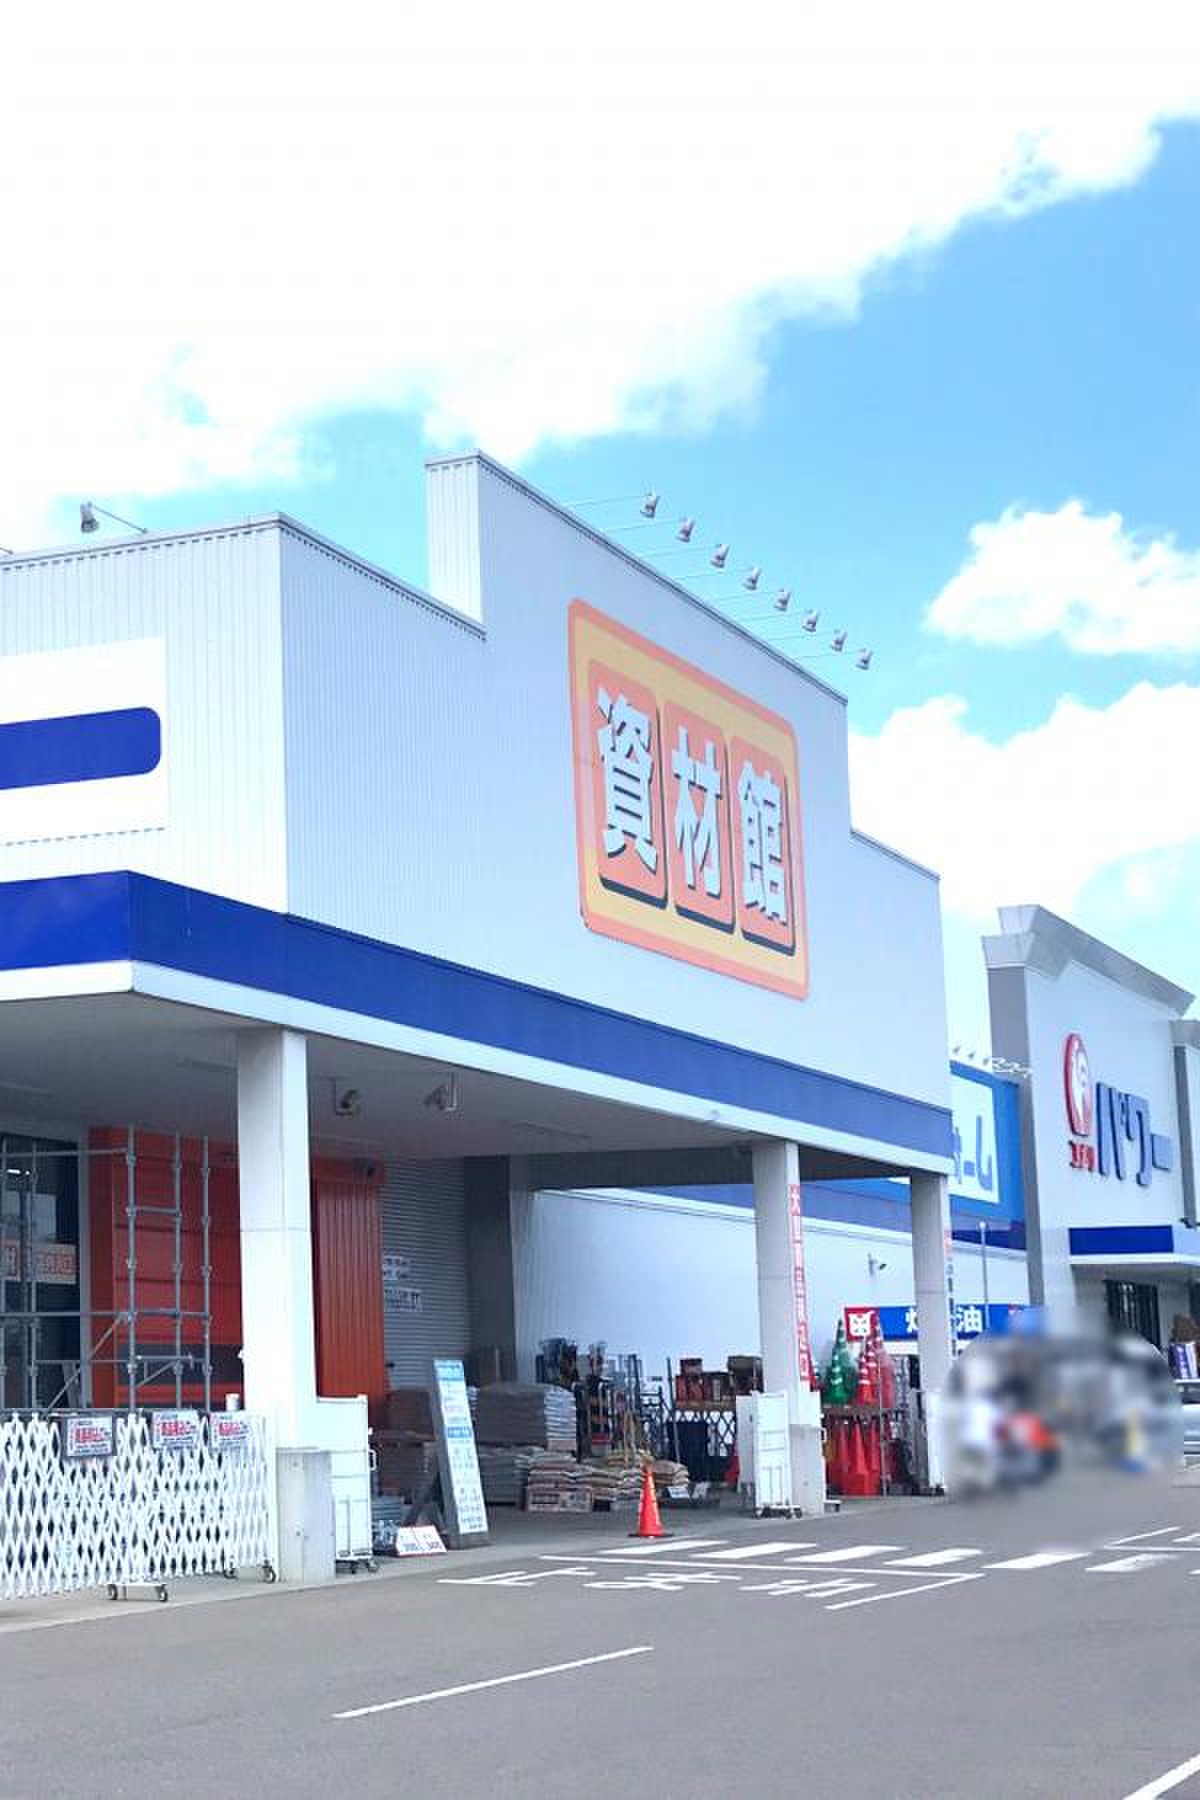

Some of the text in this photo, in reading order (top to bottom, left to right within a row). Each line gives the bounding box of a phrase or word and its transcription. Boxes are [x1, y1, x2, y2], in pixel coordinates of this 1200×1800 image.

[597, 686, 788, 926] 資材館
[952, 1115, 993, 1191] ーム
[1096, 1082, 1172, 1186] パワー
